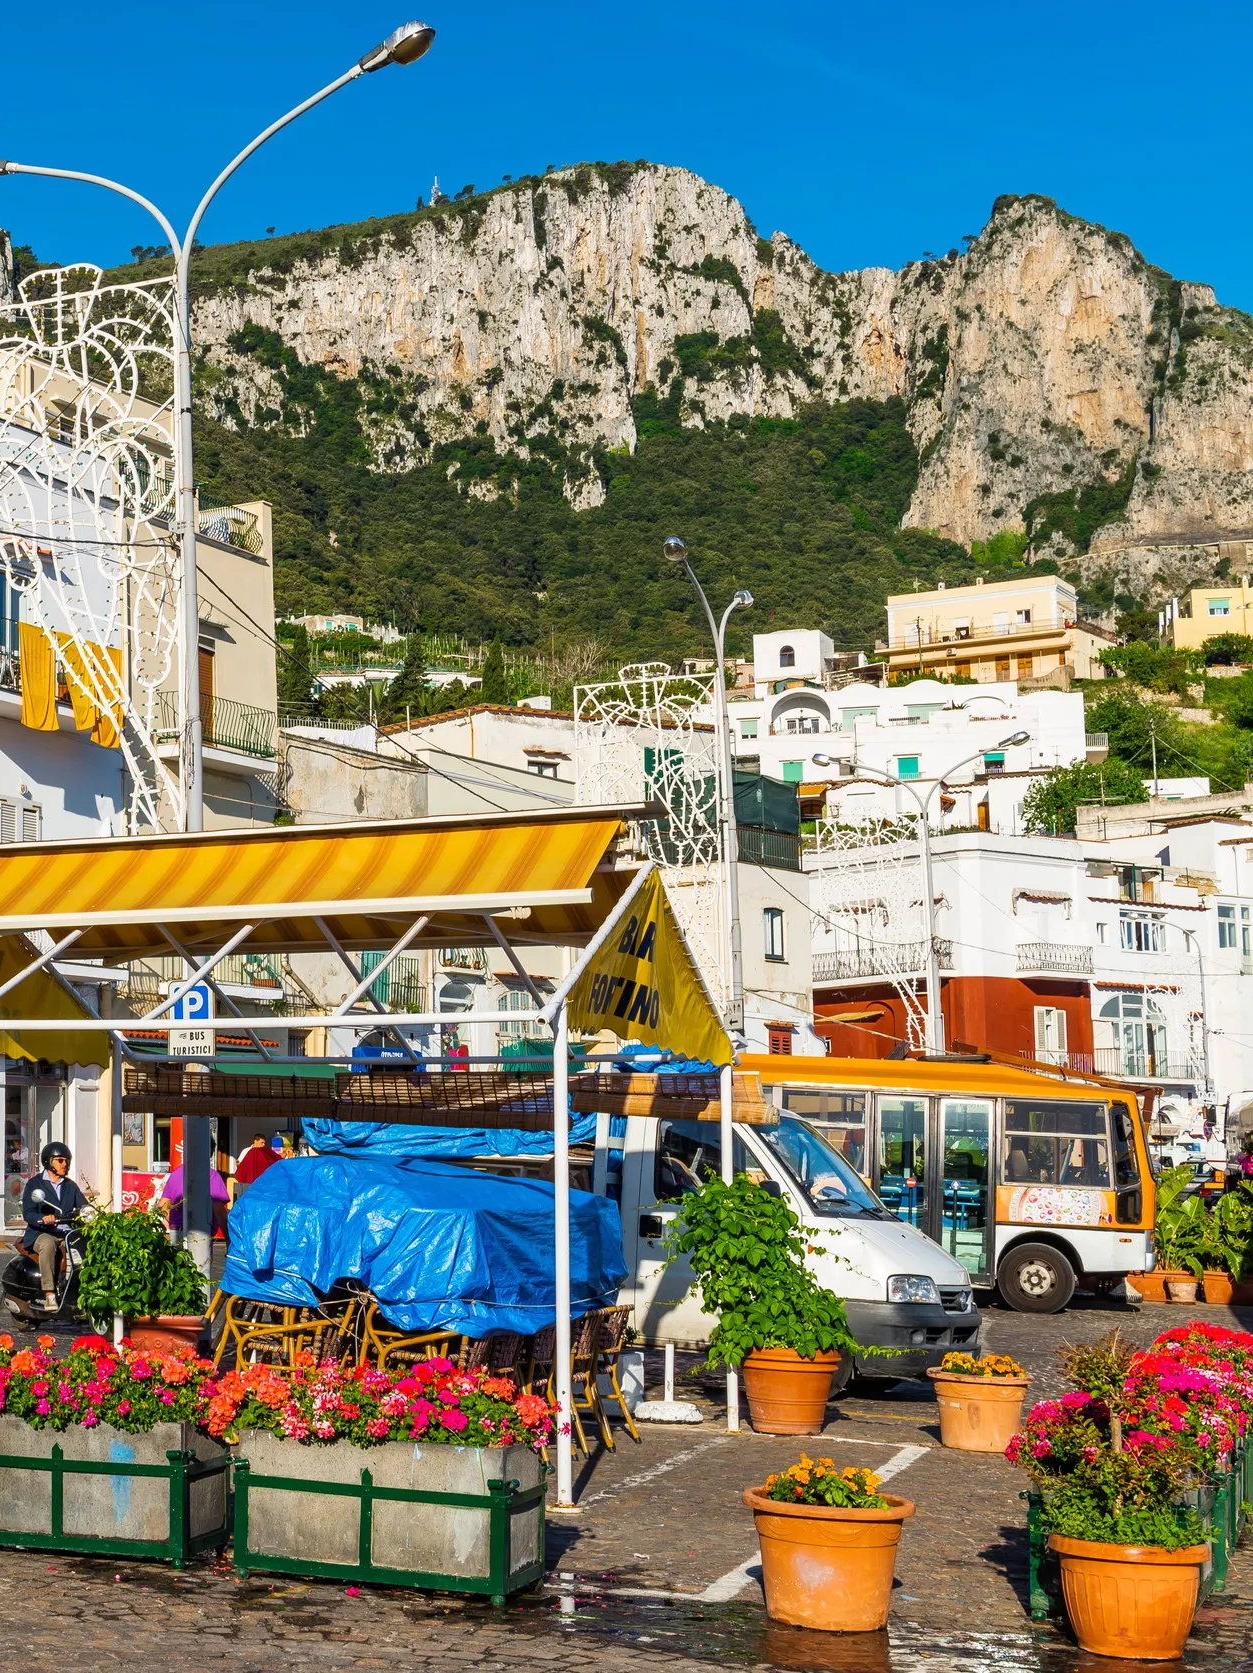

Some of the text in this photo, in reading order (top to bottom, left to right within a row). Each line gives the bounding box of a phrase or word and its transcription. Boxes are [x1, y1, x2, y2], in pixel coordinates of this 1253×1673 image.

[182, 990, 204, 1020] P
[189, 1031, 205, 1041] BUS
[172, 1045, 211, 1056] TURISTICI
